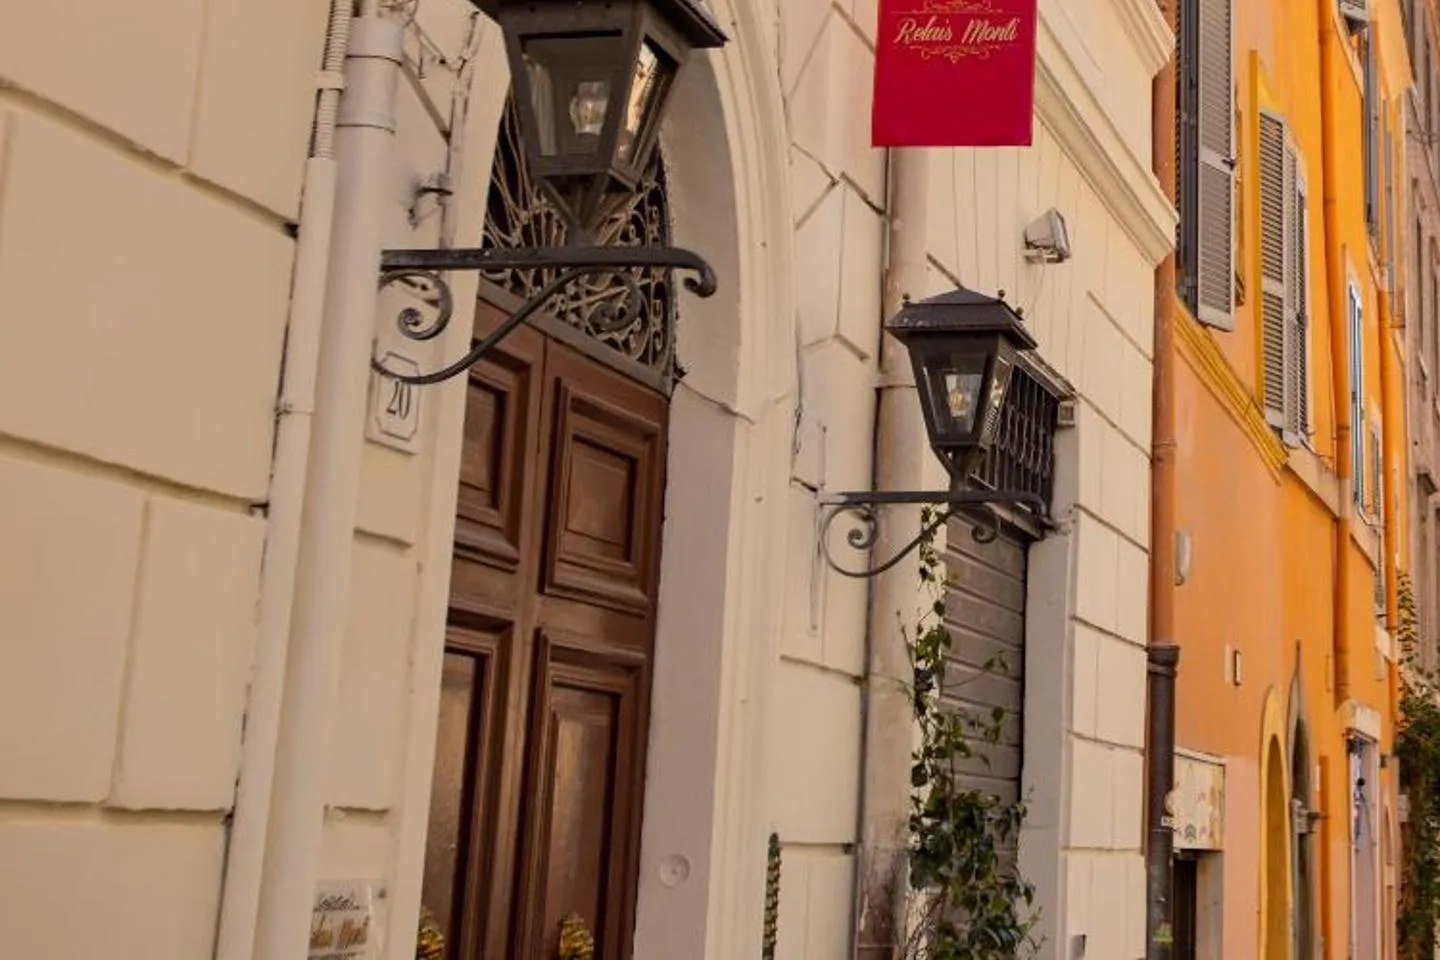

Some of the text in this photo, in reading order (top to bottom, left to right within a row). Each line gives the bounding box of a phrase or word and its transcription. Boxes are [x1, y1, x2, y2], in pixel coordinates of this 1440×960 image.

[893, 15, 1021, 44] Relais Monti
[386, 379, 411, 420] 20
